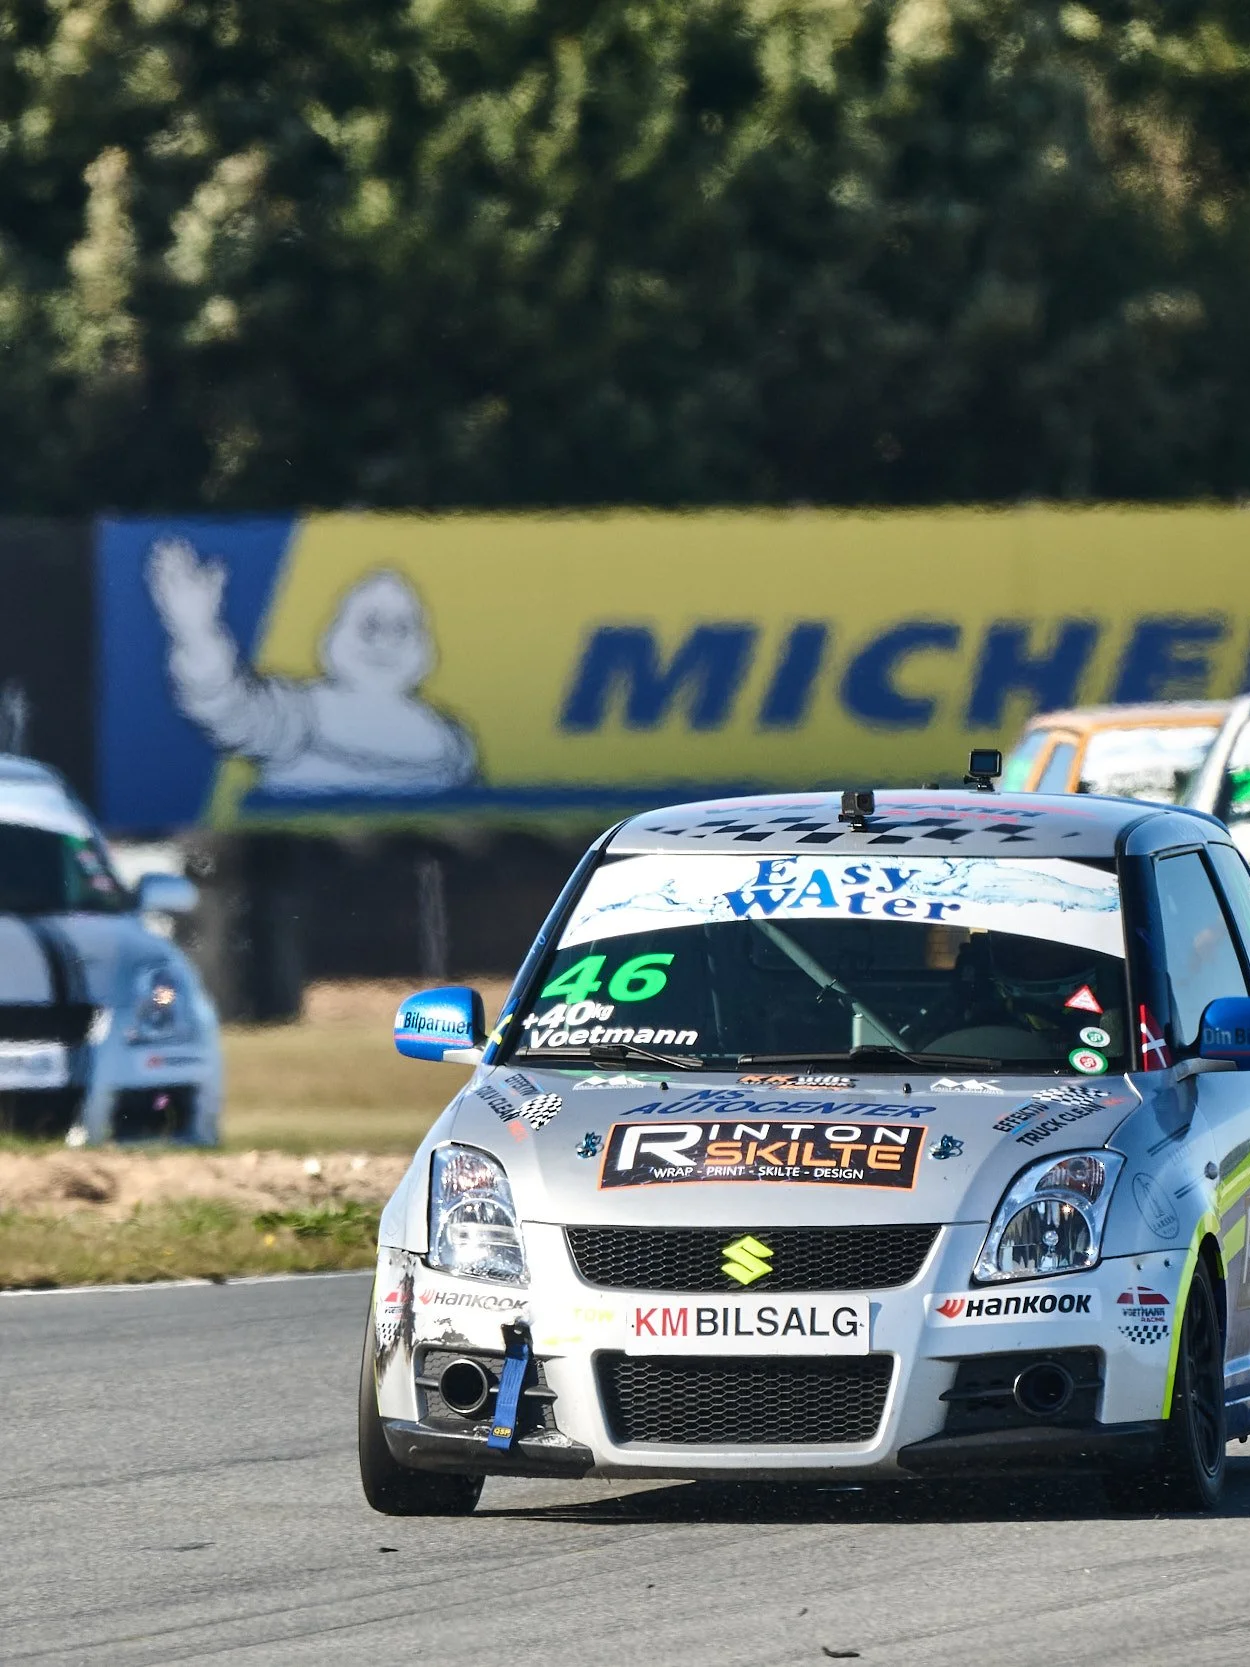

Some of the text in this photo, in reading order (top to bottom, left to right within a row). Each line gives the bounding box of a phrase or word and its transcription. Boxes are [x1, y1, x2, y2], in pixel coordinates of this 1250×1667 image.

[541, 954, 675, 1004] 46
[403, 1011, 473, 1034] Bilpartner
[530, 1025, 699, 1048] Voetmann
[1203, 1027, 1232, 1045] Din
[681, 1089, 755, 1101] NS
[619, 1101, 938, 1119] AUTOCENTER
[1016, 1102, 1107, 1146] TRUCK CLEAN
[617, 1123, 911, 1170] RINTON
[704, 1141, 905, 1170] SKILTE
[654, 1167, 694, 1178] WRAP
[706, 1166, 745, 1176] PRINT
[760, 1167, 800, 1177] SKILTE
[814, 1167, 864, 1180] DESIGN
